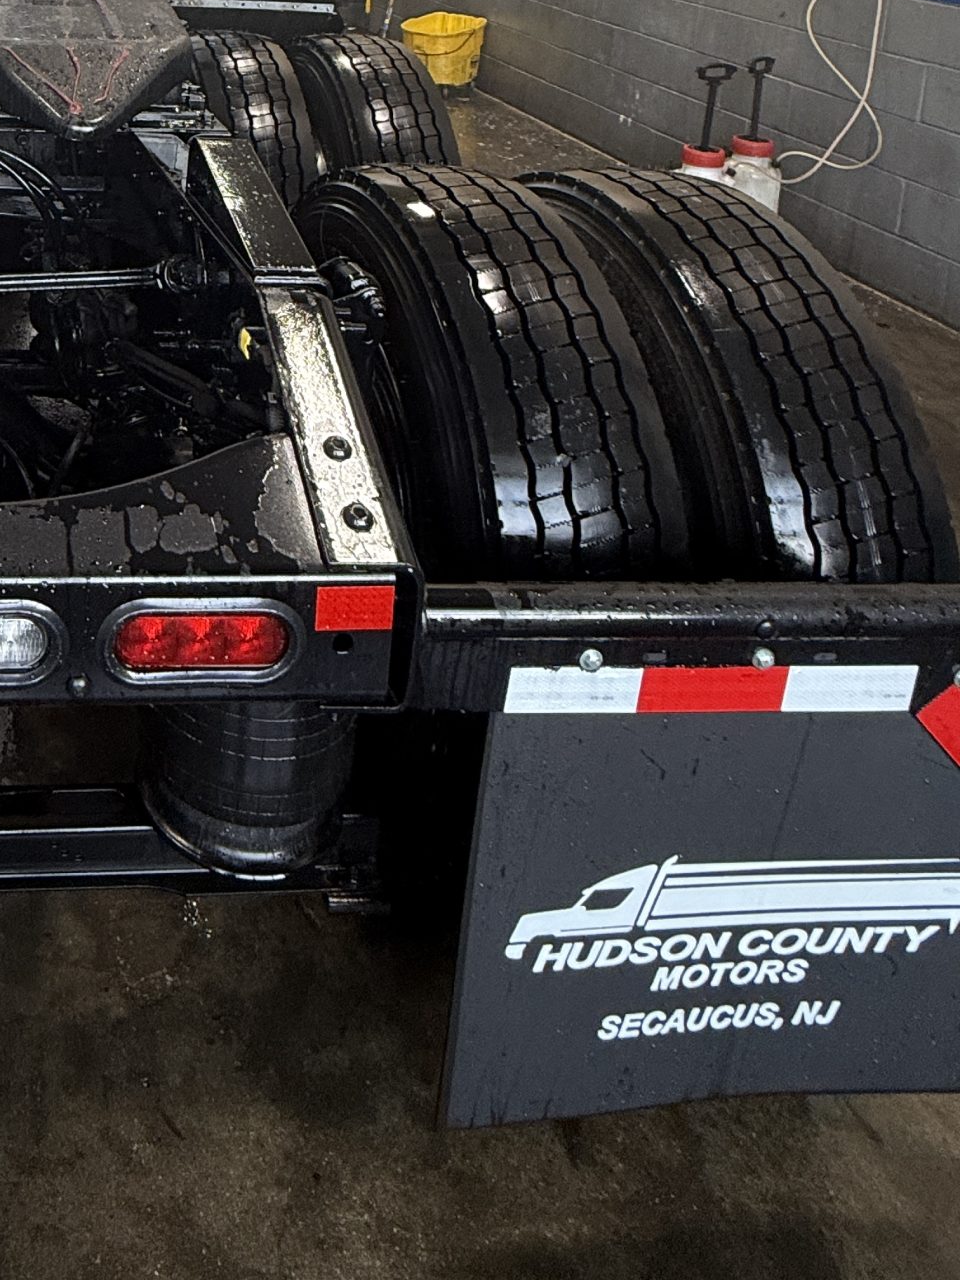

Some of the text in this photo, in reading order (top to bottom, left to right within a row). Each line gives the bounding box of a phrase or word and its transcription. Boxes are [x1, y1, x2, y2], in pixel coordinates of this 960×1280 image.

[533, 925, 941, 973] HUDSON COUNTY
[650, 959, 809, 991] MOTORS
[597, 1000, 841, 1040] SECAUCUS, NJ
